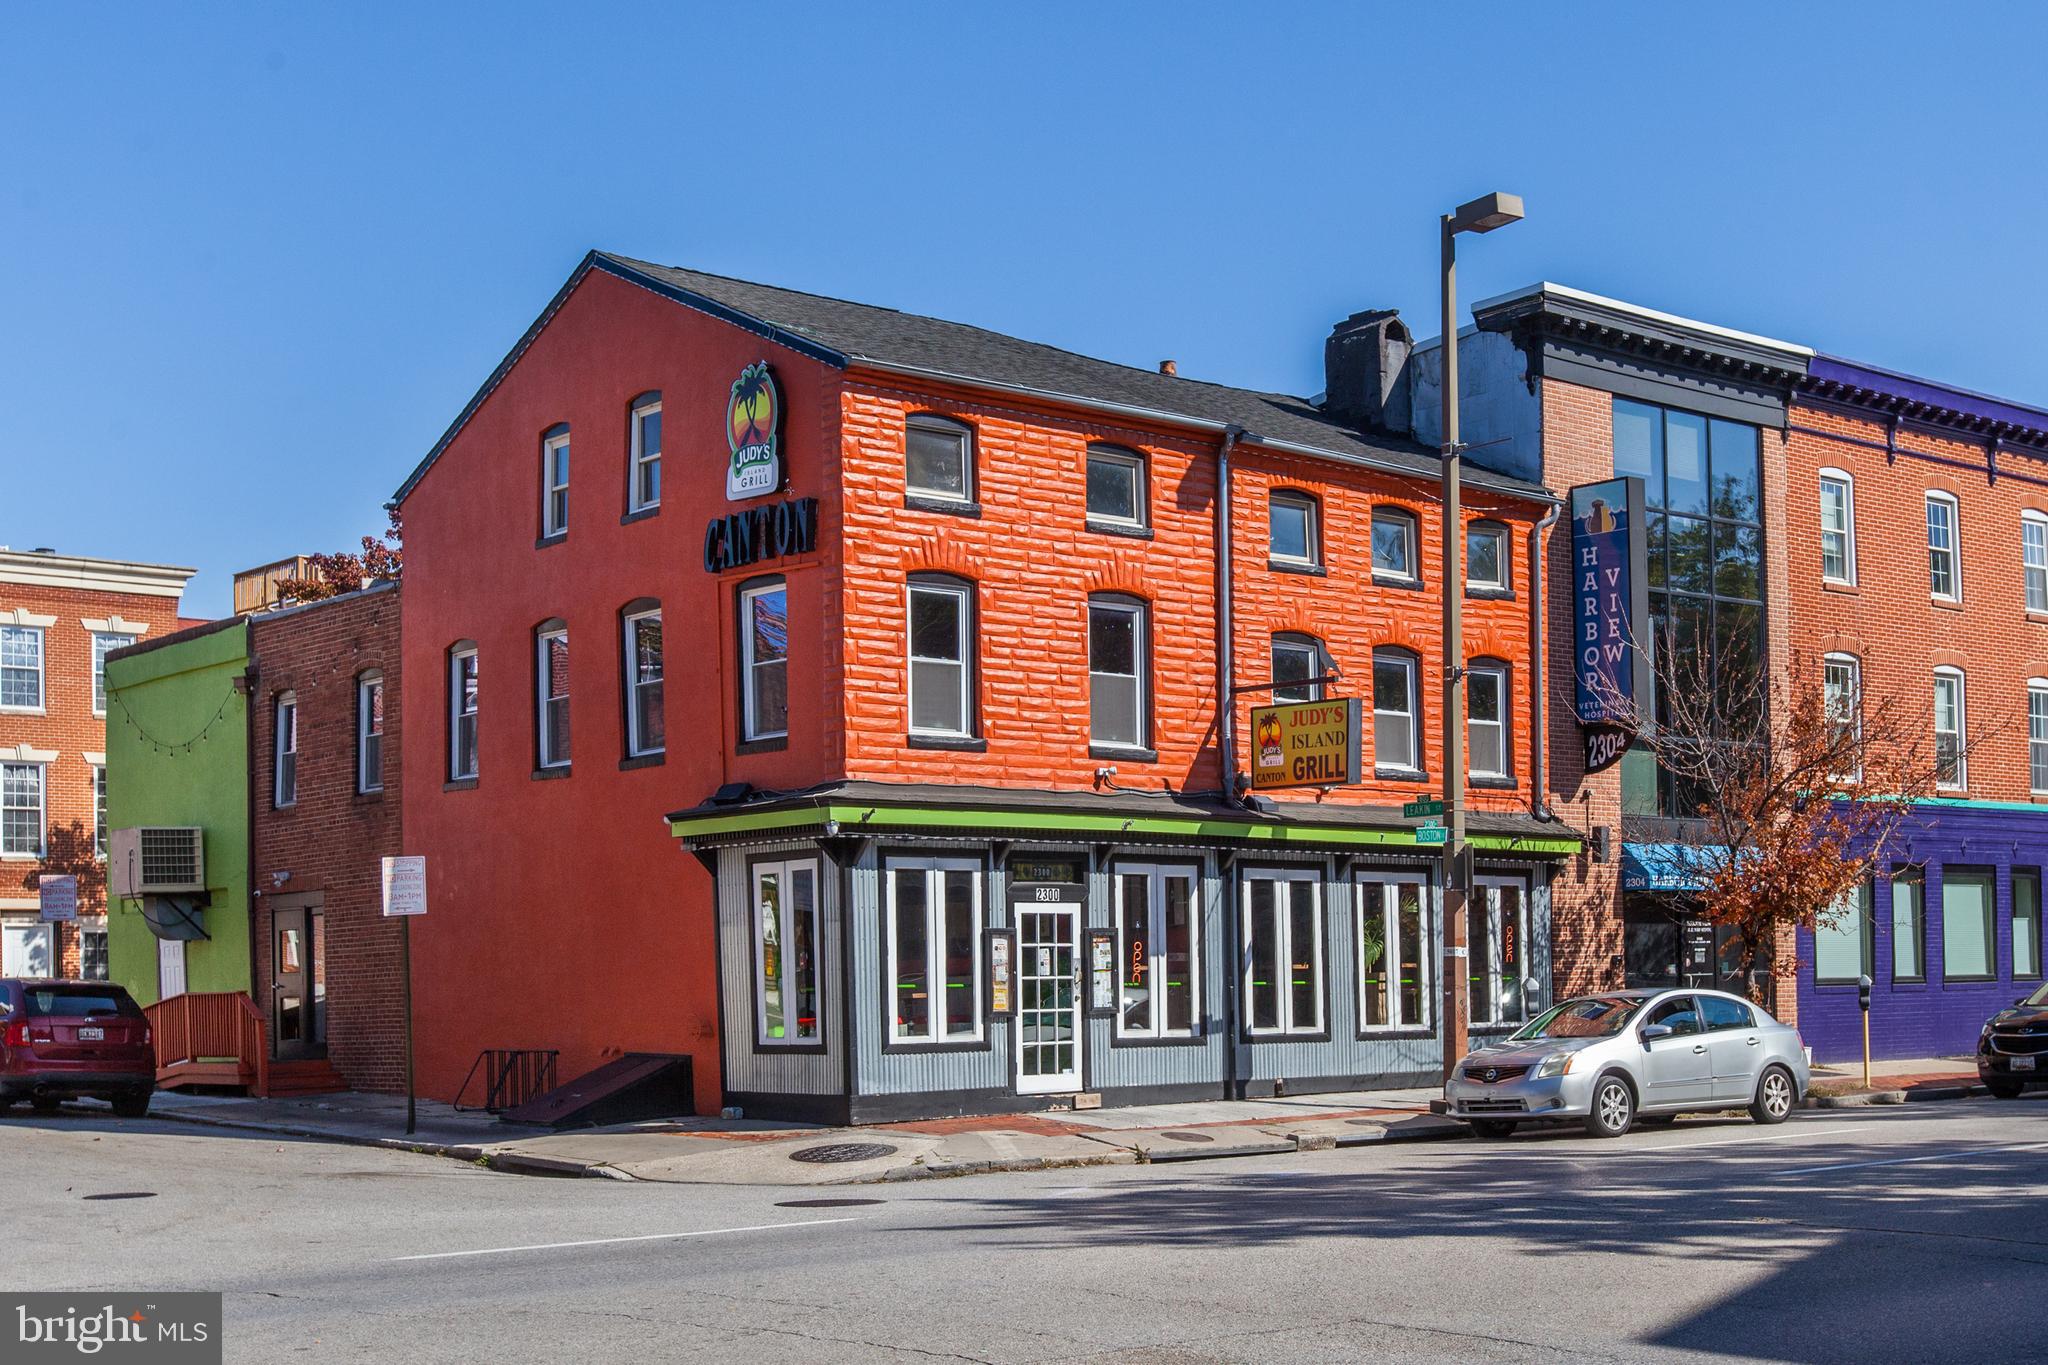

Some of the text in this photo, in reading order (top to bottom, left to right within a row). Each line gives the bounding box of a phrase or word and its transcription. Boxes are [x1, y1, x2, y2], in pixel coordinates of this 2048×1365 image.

[736, 444, 770, 468] JUDY'S
[744, 467, 766, 476] ISLAND
[741, 475, 768, 488] GRILL
[704, 498, 818, 573] CANTON
[1582, 546, 1599, 691] HARBOR
[1605, 567, 1625, 663] VIEW
[1290, 706, 1344, 728] JUDY'S
[1291, 730, 1345, 750] ISLAND
[1262, 746, 1281, 757] JUDY'S
[1588, 732, 1626, 768] 2304
[1293, 753, 1345, 781] GRILL
[1256, 772, 1286, 784] CANTON
[1405, 804, 1431, 816] LEAKIN
[1417, 830, 1441, 841] BOSTON
[1625, 877, 1645, 888] 2304
[1037, 888, 1059, 901] 2300
